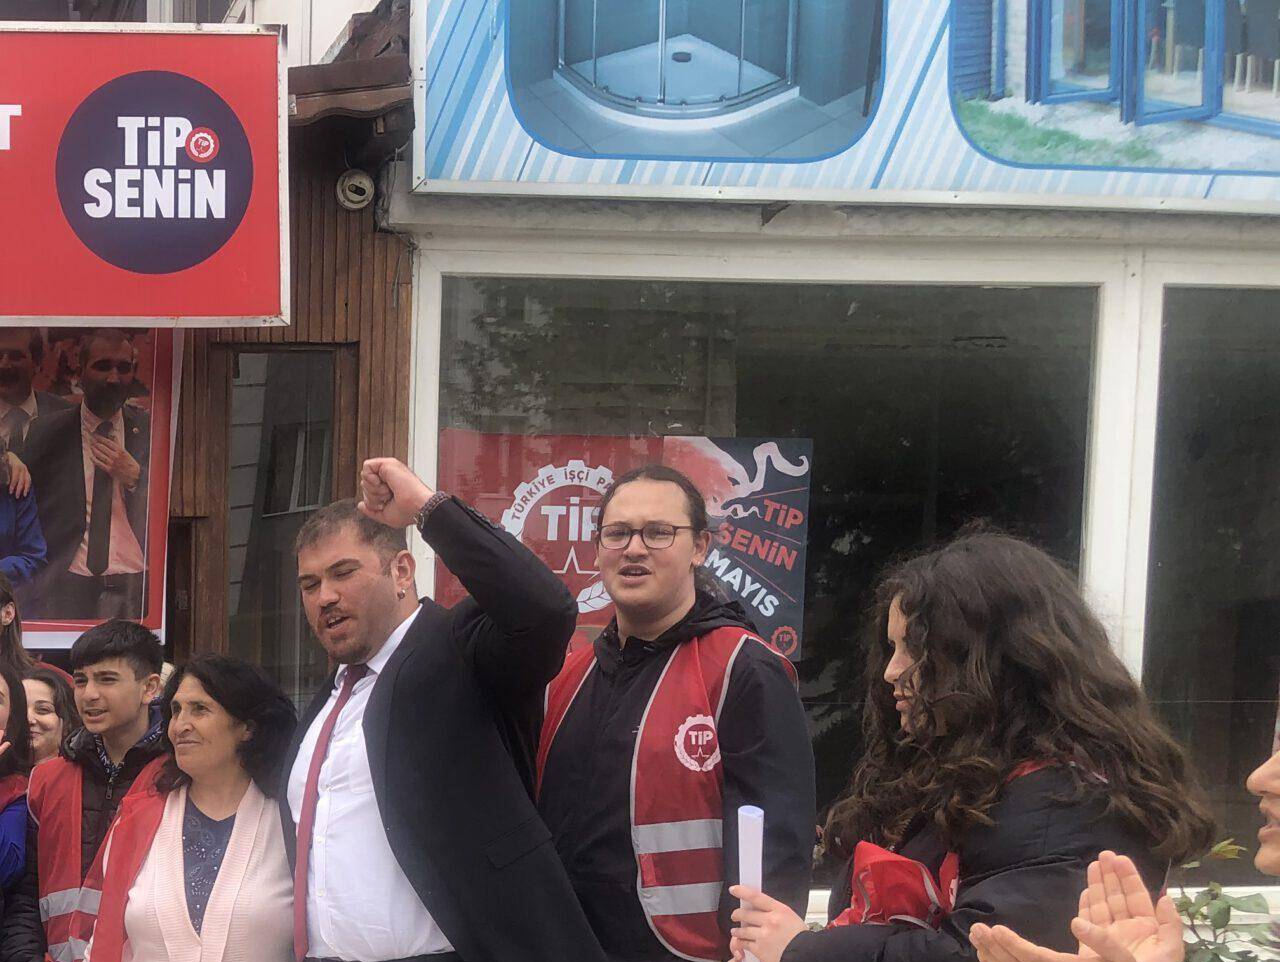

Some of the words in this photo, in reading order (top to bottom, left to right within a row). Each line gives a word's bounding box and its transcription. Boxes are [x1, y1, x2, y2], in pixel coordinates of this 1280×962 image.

[511, 474, 557, 521] TÜRKİYE
[564, 468, 591, 483] İŞÇİ
[704, 548, 780, 617] MAYIS
